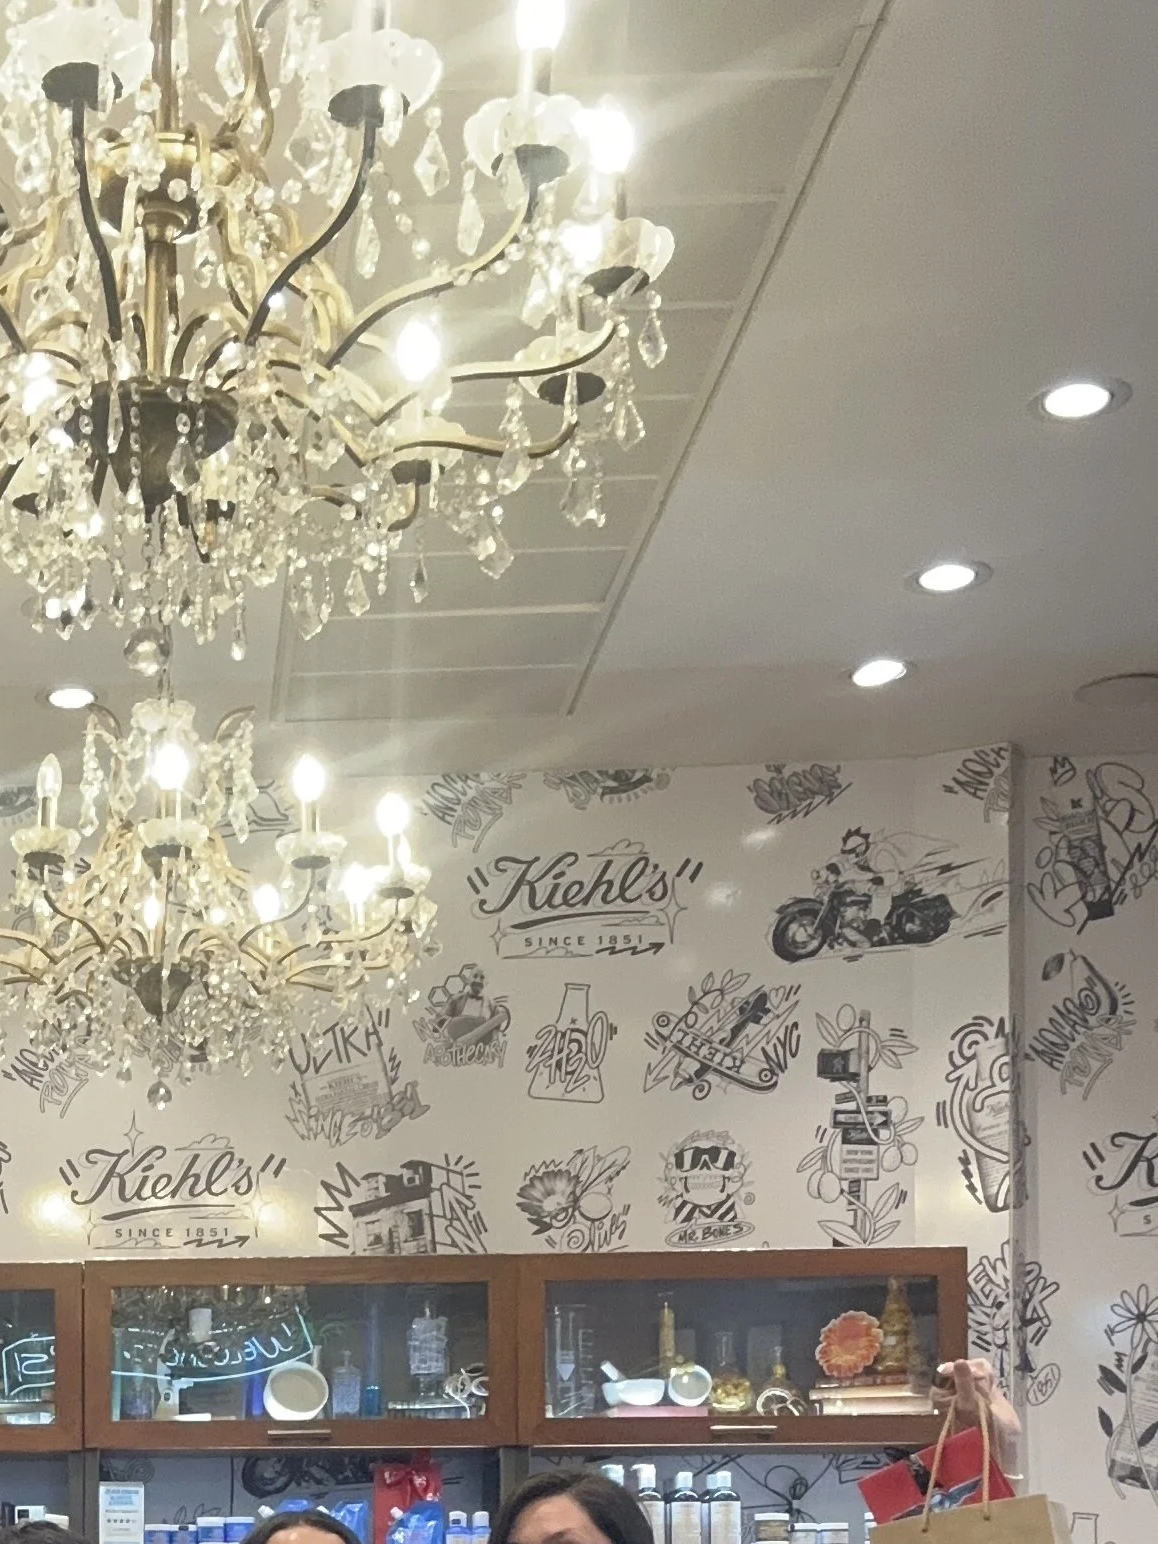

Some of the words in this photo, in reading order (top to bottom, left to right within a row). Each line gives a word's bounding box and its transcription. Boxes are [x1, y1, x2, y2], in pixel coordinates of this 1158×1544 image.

[478, 851, 668, 914] Kiehl's
[525, 935, 585, 948] SINCE
[598, 934, 643, 946] 1851
[761, 1021, 801, 1073] NYC
[70, 1145, 253, 1205] Kiehl's
[115, 1227, 173, 1239] SINCE
[186, 1227, 229, 1238] 1851
[702, 1224, 743, 1241] BONES
